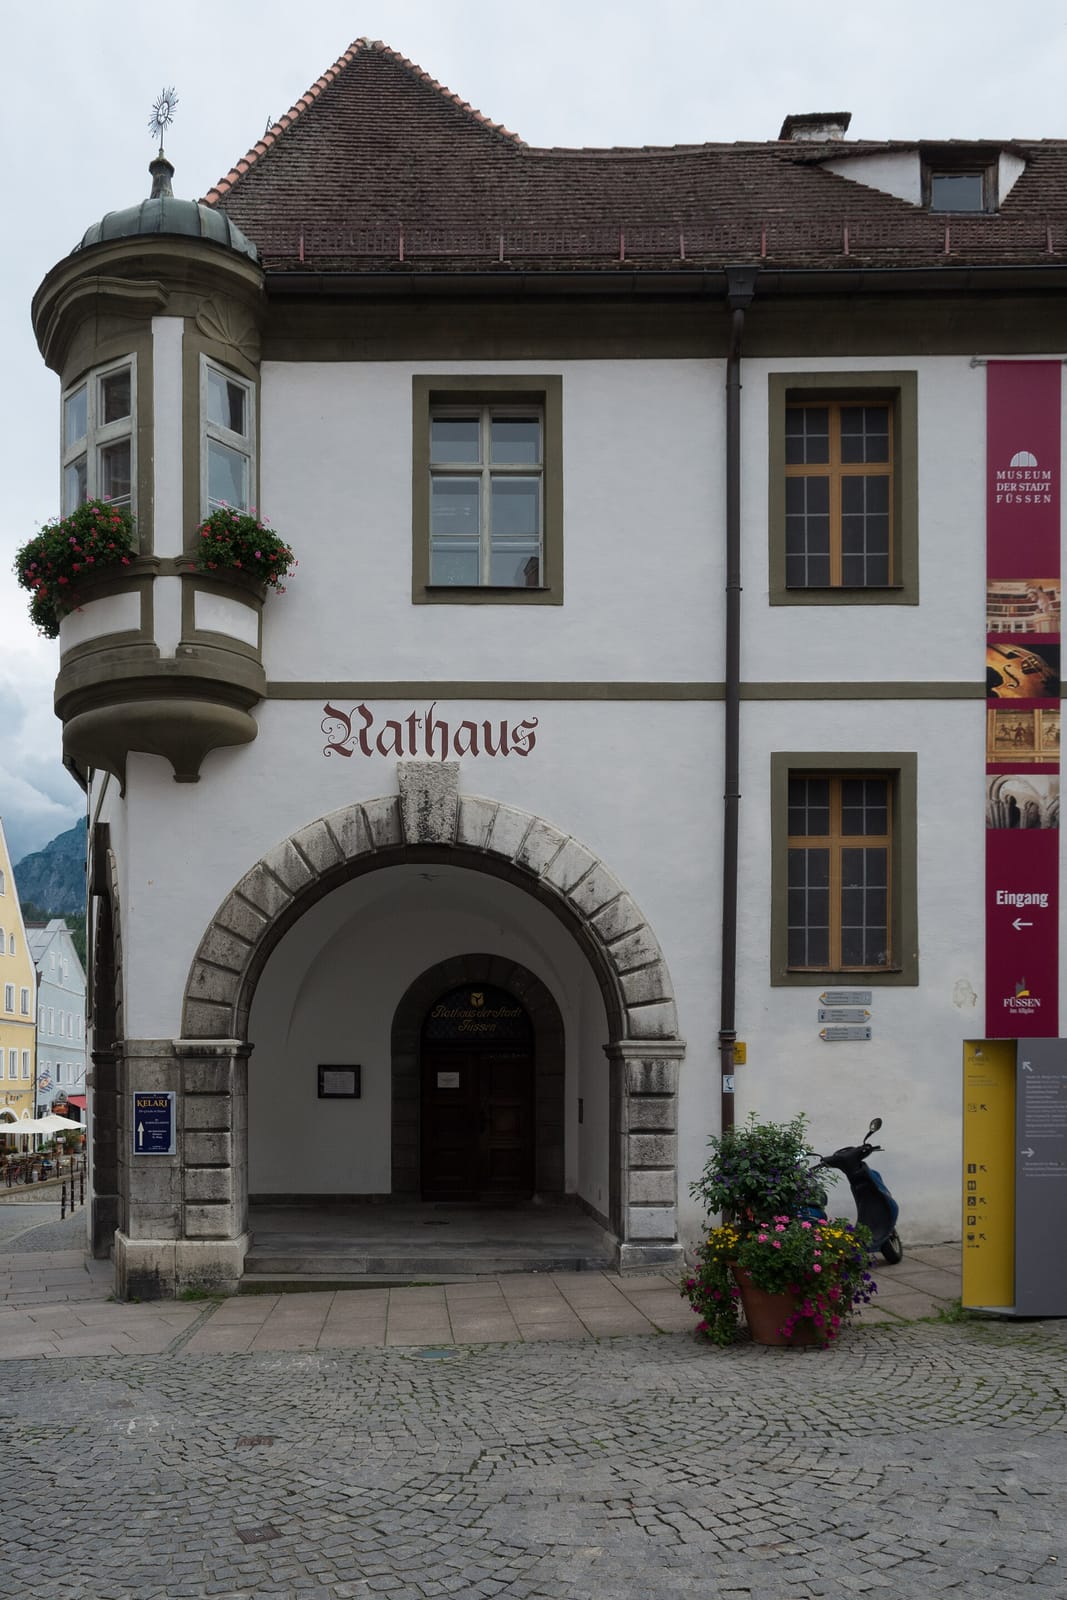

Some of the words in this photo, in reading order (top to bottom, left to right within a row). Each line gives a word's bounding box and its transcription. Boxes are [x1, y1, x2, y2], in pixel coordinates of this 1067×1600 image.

[996, 470, 1051, 480] MUSEUM
[996, 482, 1017, 492] DER
[1018, 482, 1051, 492] STADT
[996, 493, 1052, 504] FÜSSEN
[320, 701, 539, 761] Rathaus
[996, 890, 1049, 908] Eingang
[1003, 997, 1041, 1008] FÜSSEN
[431, 1005, 476, 1018] Rathaus
[137, 1099, 168, 1108] KELARI
